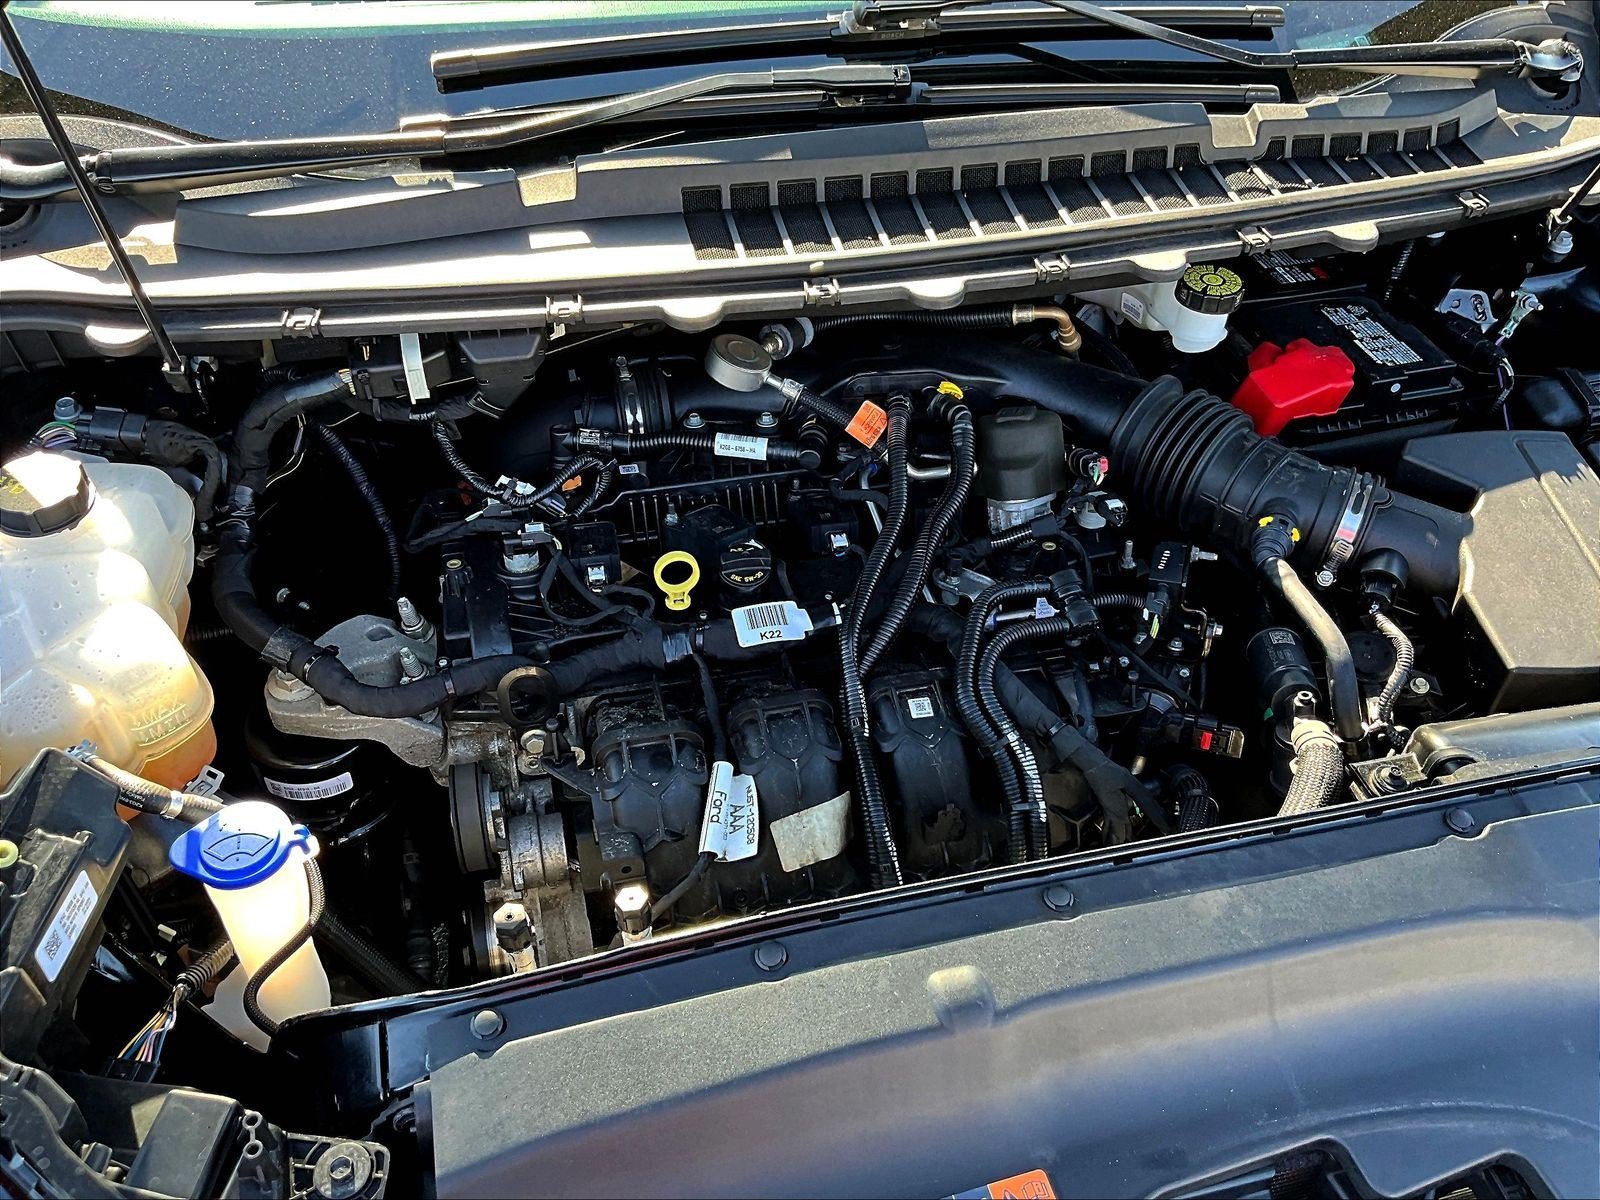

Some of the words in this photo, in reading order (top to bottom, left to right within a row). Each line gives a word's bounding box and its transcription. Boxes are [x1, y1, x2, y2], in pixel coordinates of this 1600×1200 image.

[760, 630, 782, 640] K22
[709, 790, 727, 825] Ford
[729, 804, 745, 835] AAA
